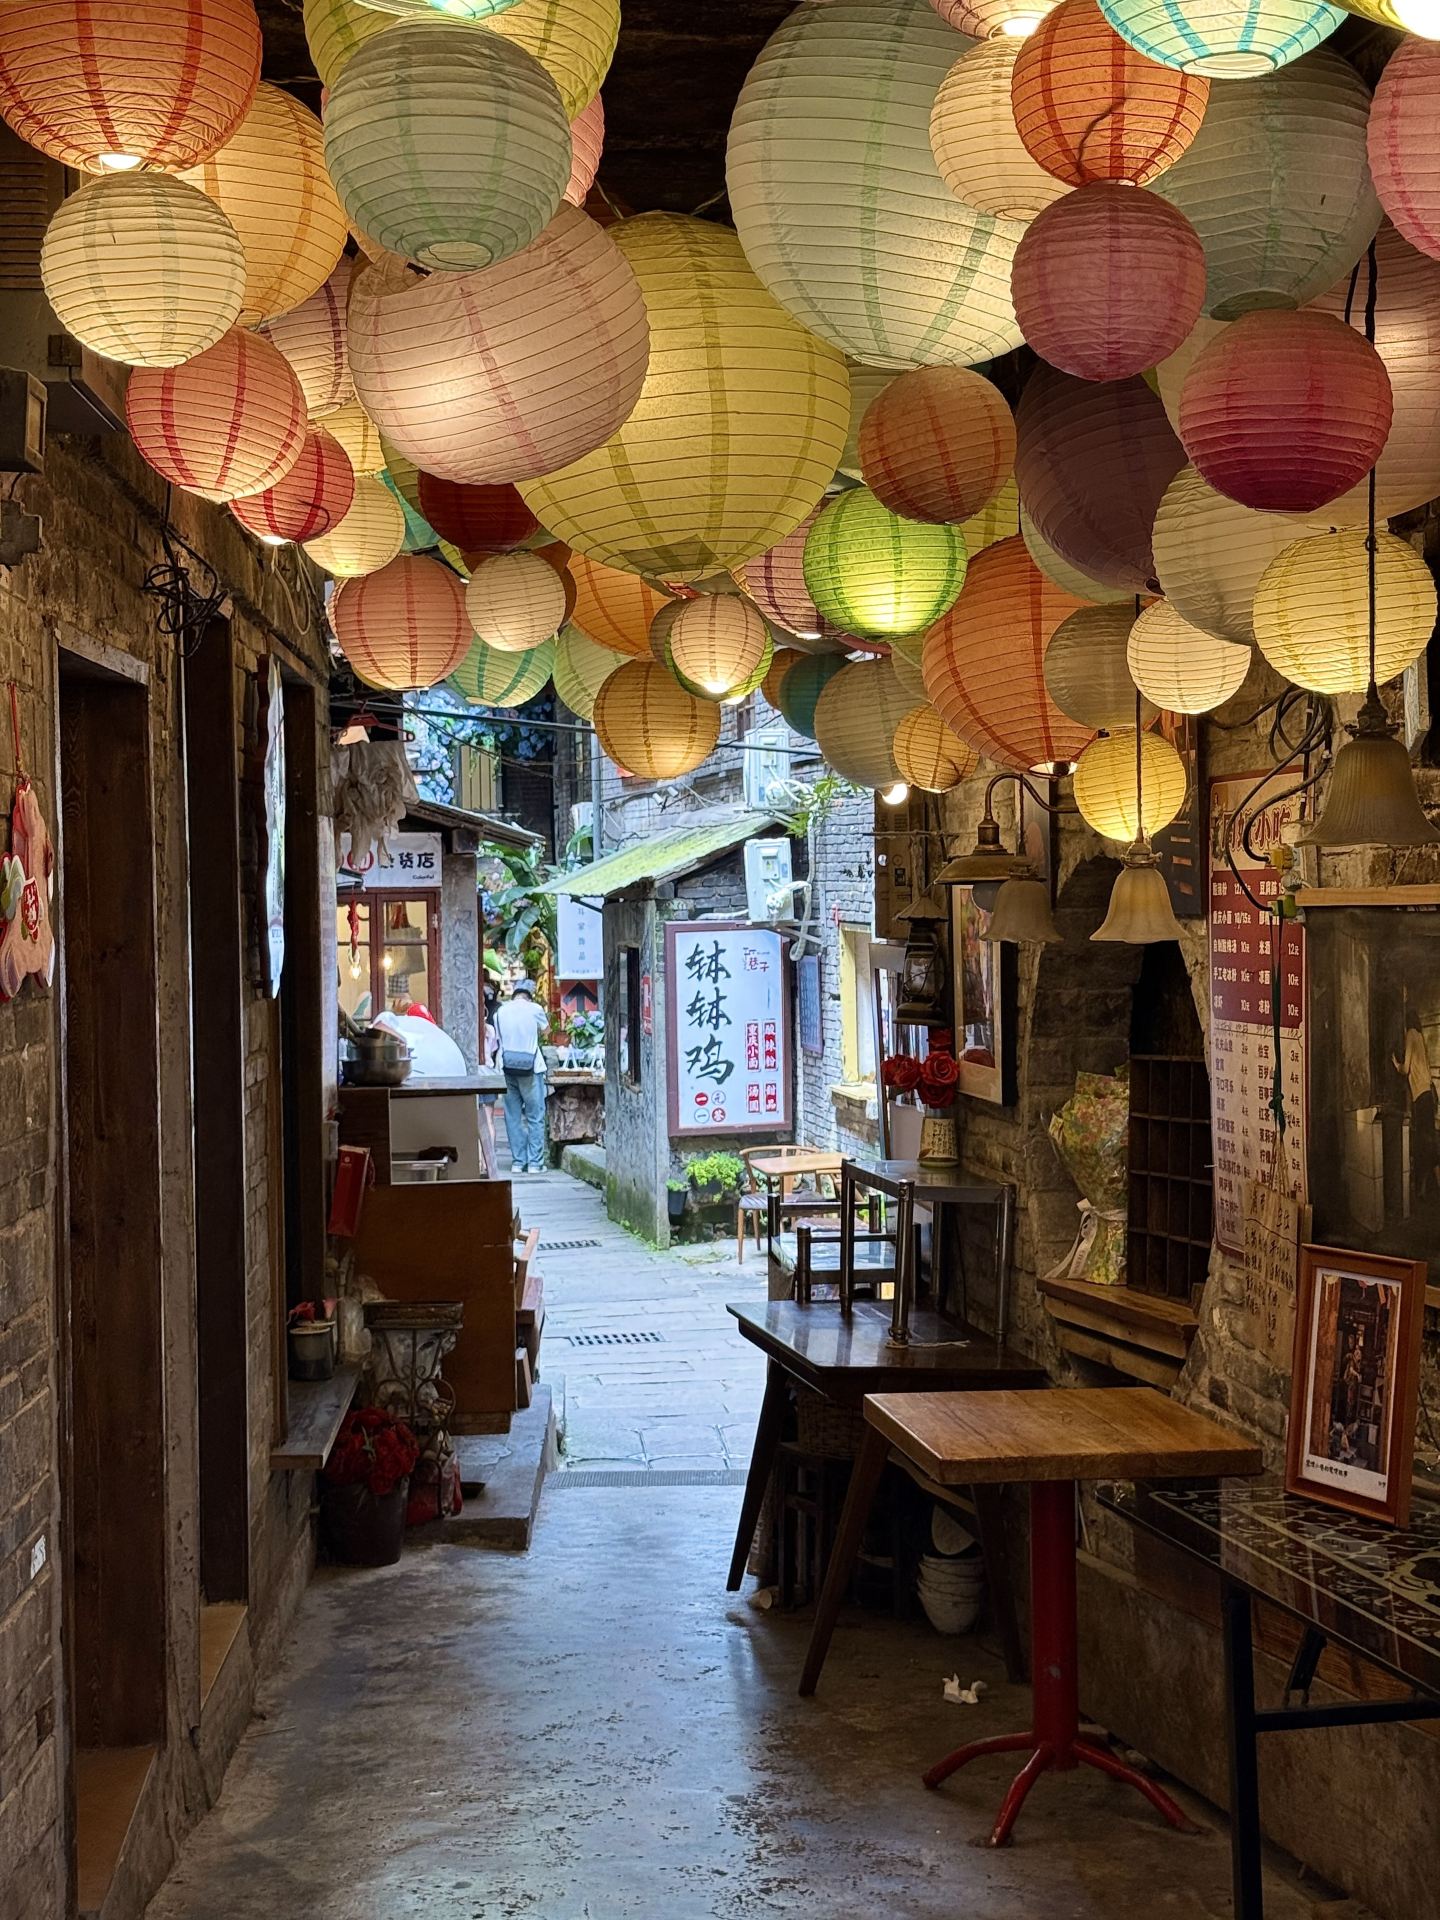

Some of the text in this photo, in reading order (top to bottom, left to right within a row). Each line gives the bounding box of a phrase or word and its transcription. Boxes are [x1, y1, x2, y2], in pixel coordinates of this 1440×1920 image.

[1213, 910, 1232, 925] 重庆小面
[1259, 940, 1271, 955] 米酒
[1288, 943, 1299, 956] 12元
[1288, 973, 1299, 986] 10元
[685, 940, 734, 1085] 钵钵鸡
[1288, 1003, 1299, 1017] 10元
[746, 1022, 759, 1069] 重庆小面
[1291, 1049, 1299, 1062] 3元
[1290, 1071, 1299, 1085] 4元
[1215, 1077, 1234, 1094] 可口可乐
[1258, 1085, 1274, 1101] 百事可
[1291, 1092, 1299, 1106] 4元
[1259, 1107, 1270, 1122] 红茶
[1291, 1115, 1300, 1128] 4元
[1291, 1136, 1300, 1150] 4元
[1292, 1158, 1300, 1171] 5元
